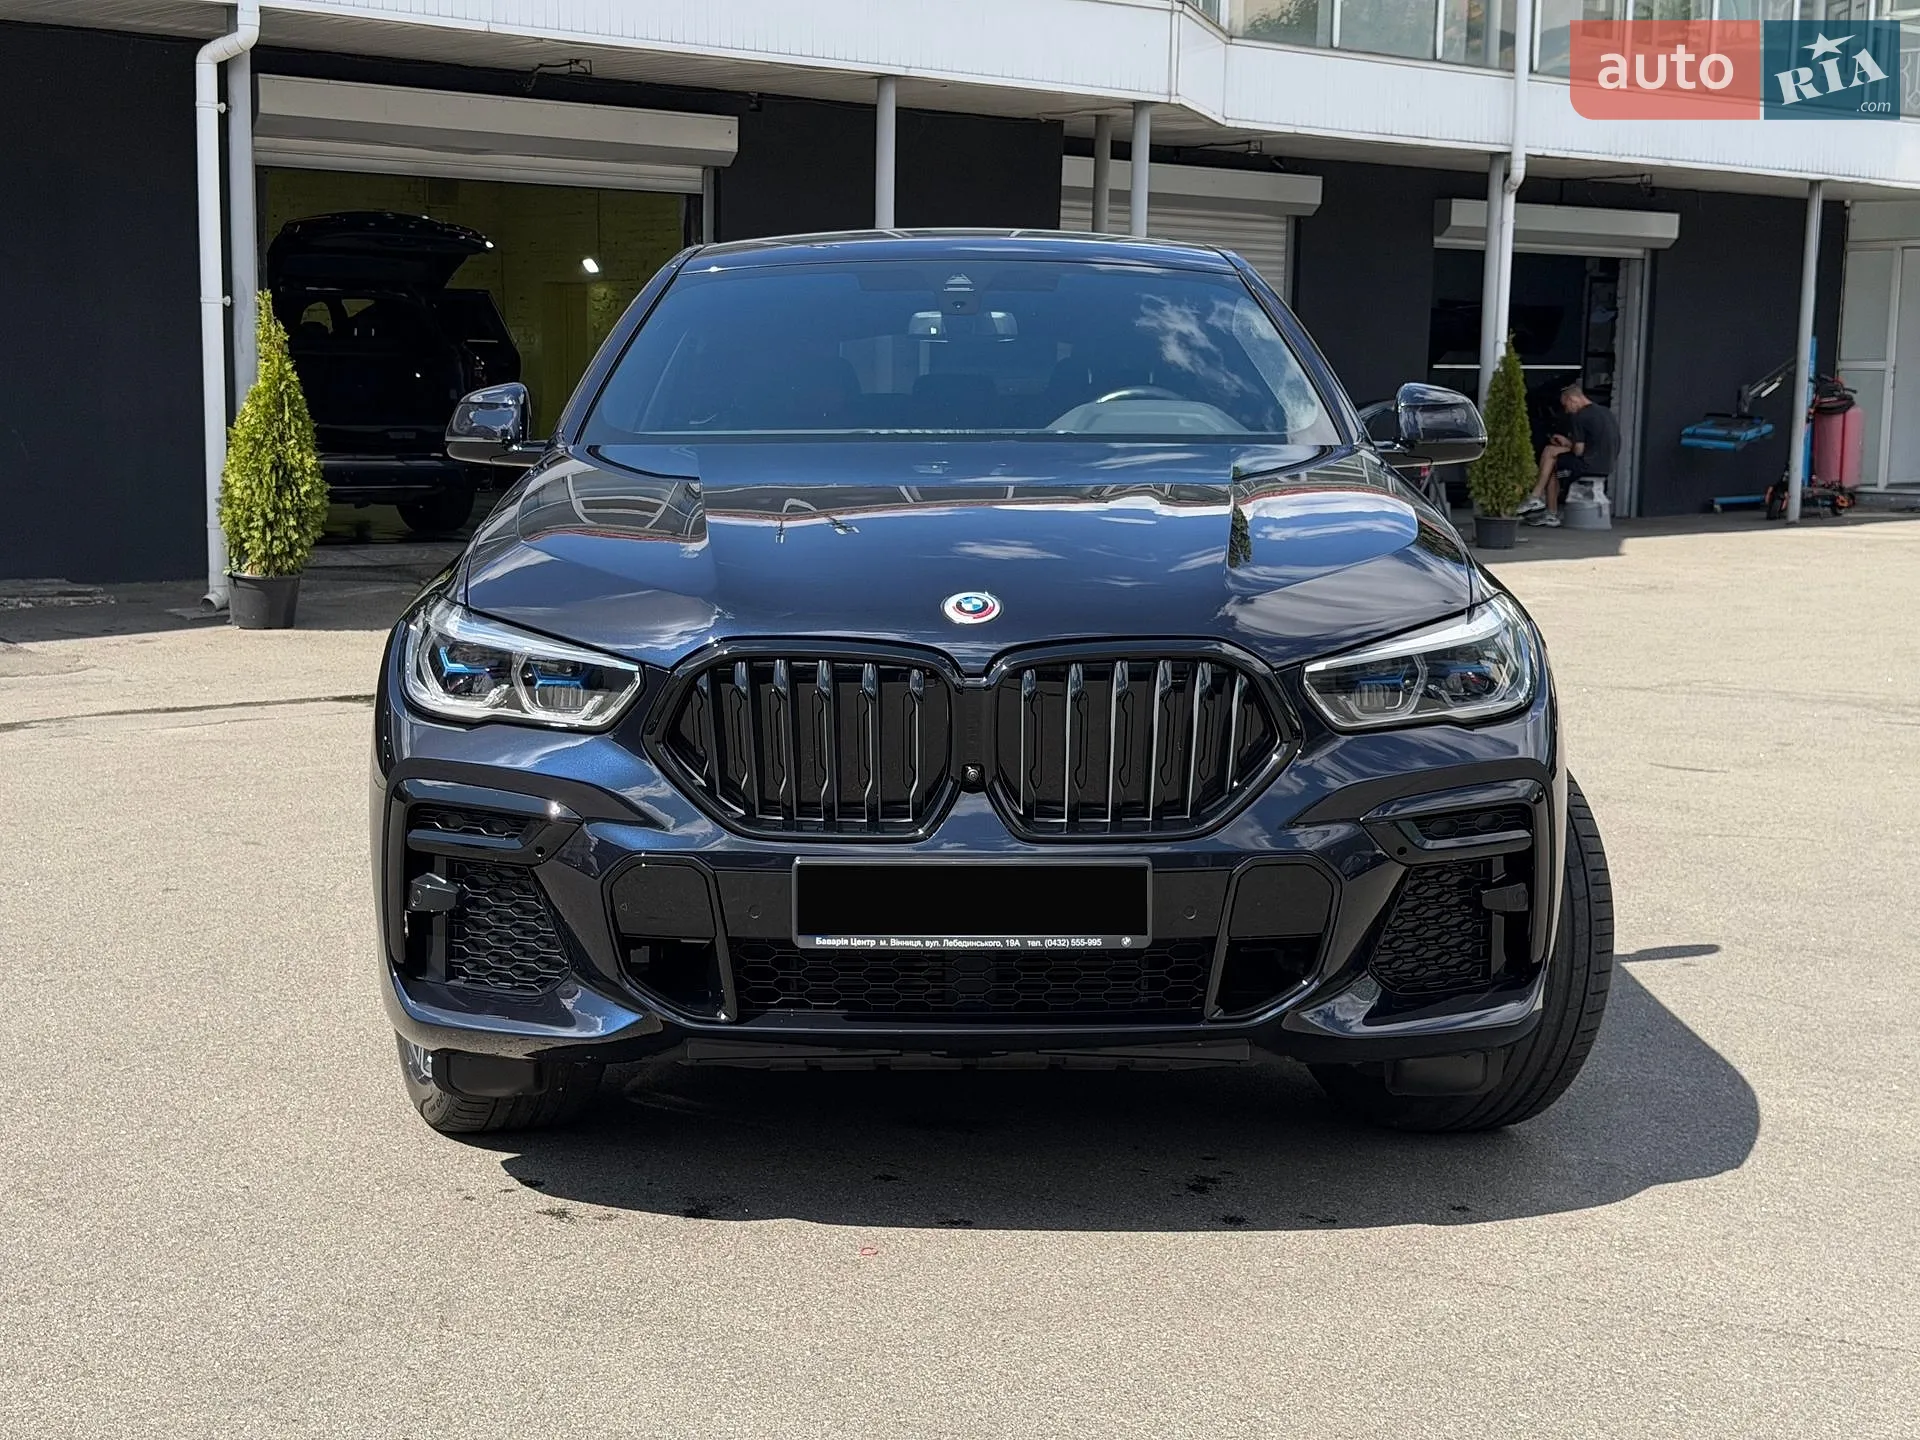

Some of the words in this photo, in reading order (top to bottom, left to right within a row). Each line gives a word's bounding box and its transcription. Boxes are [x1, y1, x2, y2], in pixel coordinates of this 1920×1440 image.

[815, 937, 849, 947] Баварія
[850, 938, 877, 948] Центр
[890, 939, 924, 948] Вінниця,
[925, 940, 941, 948] вул.
[1044, 939, 1070, 948] (0432)
[1071, 938, 1103, 947] 555-995
